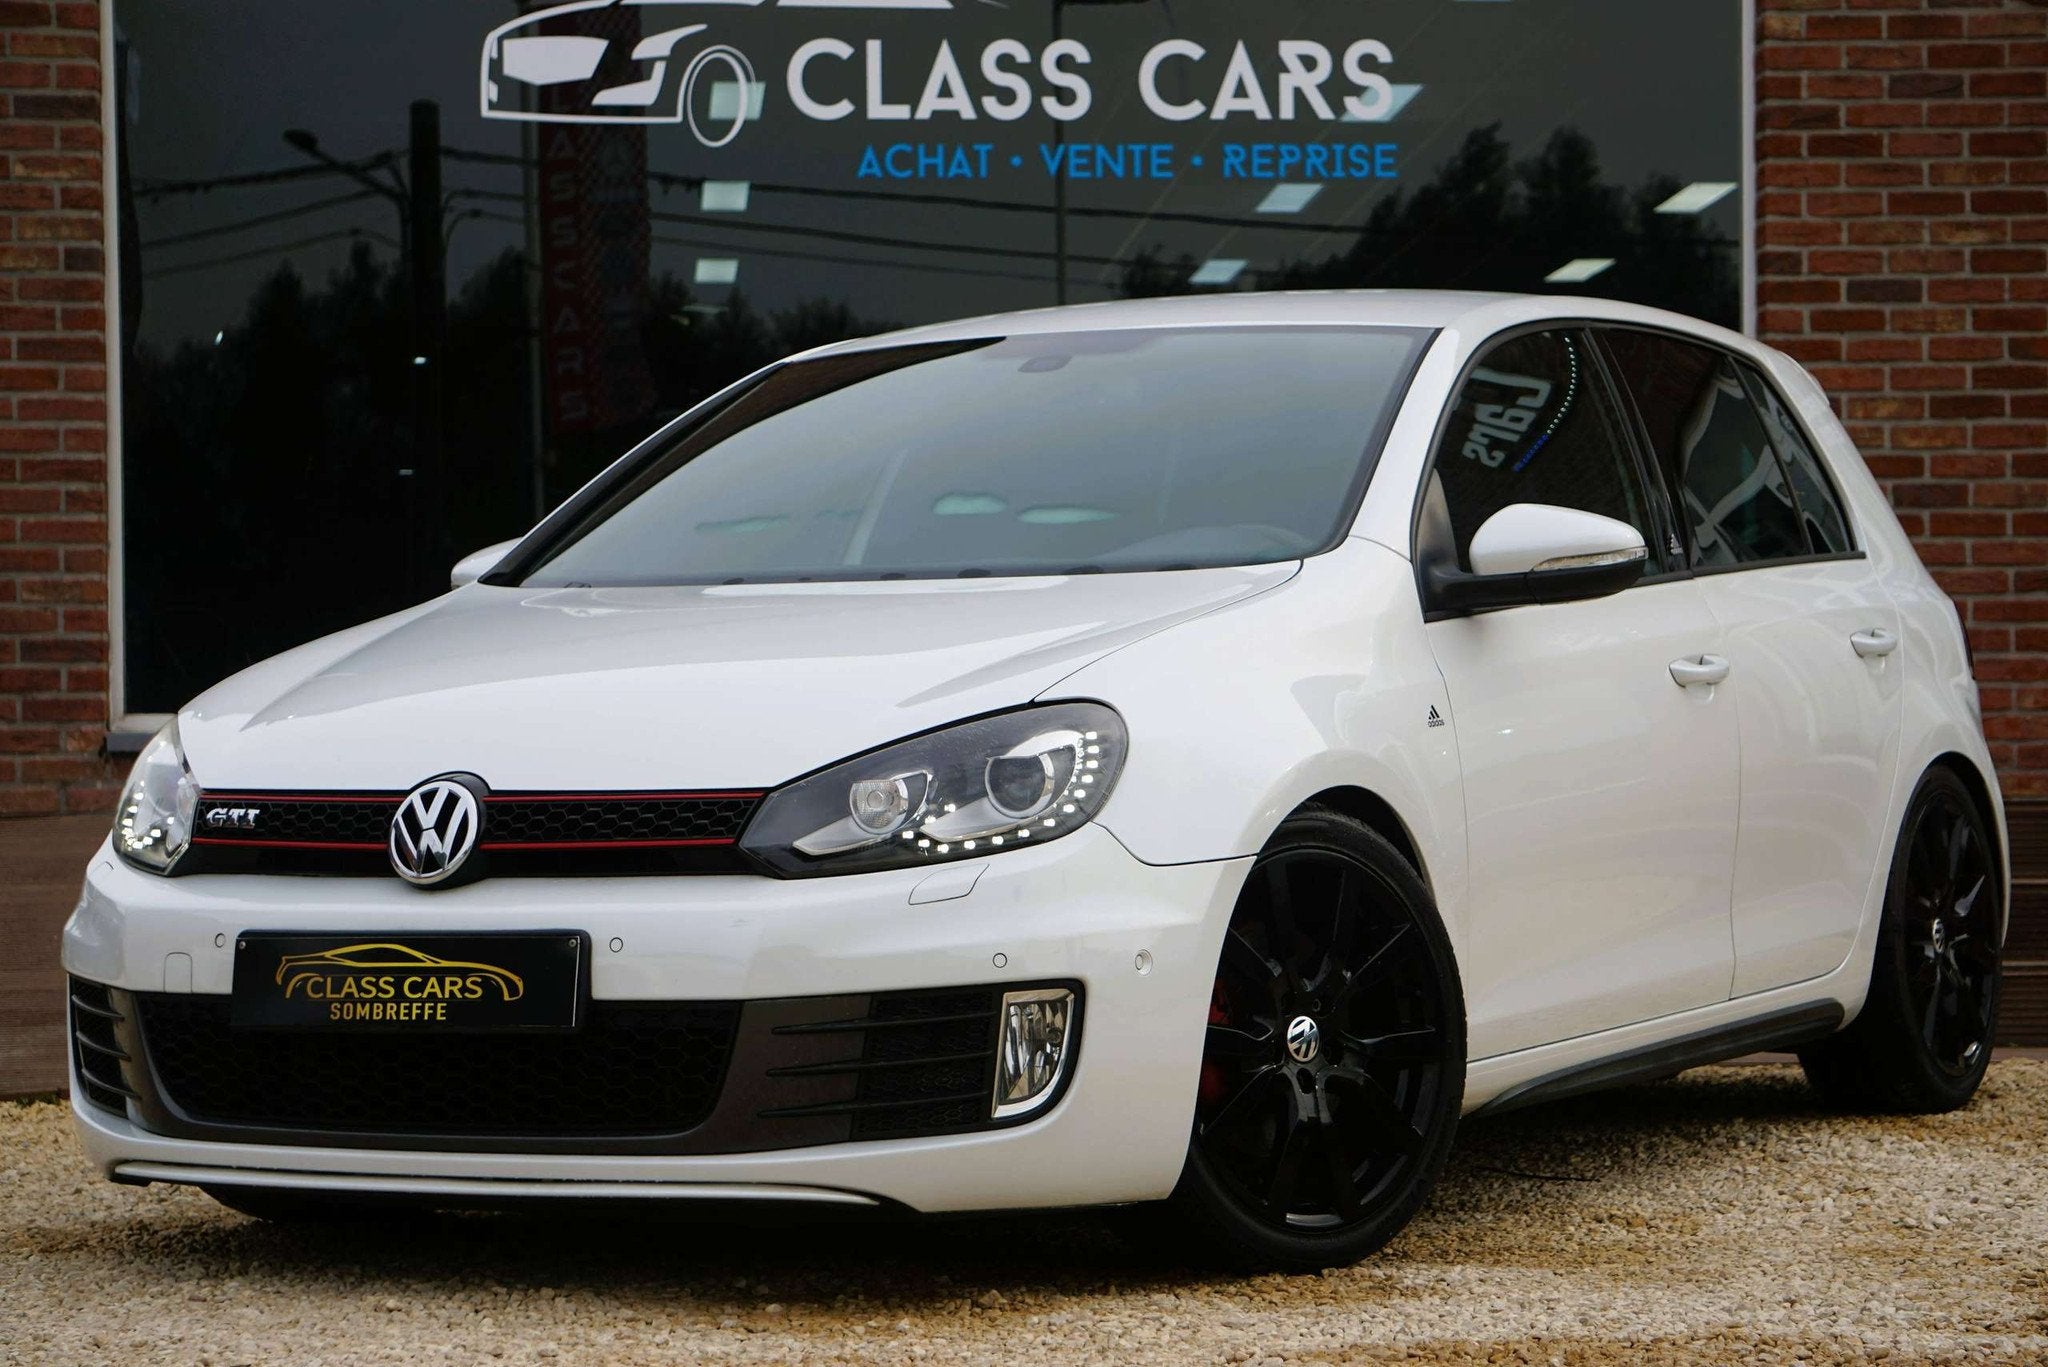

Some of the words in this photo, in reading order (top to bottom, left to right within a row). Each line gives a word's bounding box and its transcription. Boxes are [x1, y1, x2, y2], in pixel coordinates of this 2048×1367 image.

[787, 38, 1092, 121] CLASS
[1138, 38, 1394, 121] CARS
[857, 143, 993, 179] ACHAT
[1039, 143, 1174, 179] VENTE
[1223, 143, 1398, 179] REPRISE
[206, 808, 260, 830] GTI
[306, 975, 396, 1000] CLASS
[402, 975, 484, 1000] CARS
[329, 1001, 447, 1021] SOMBREFFE
